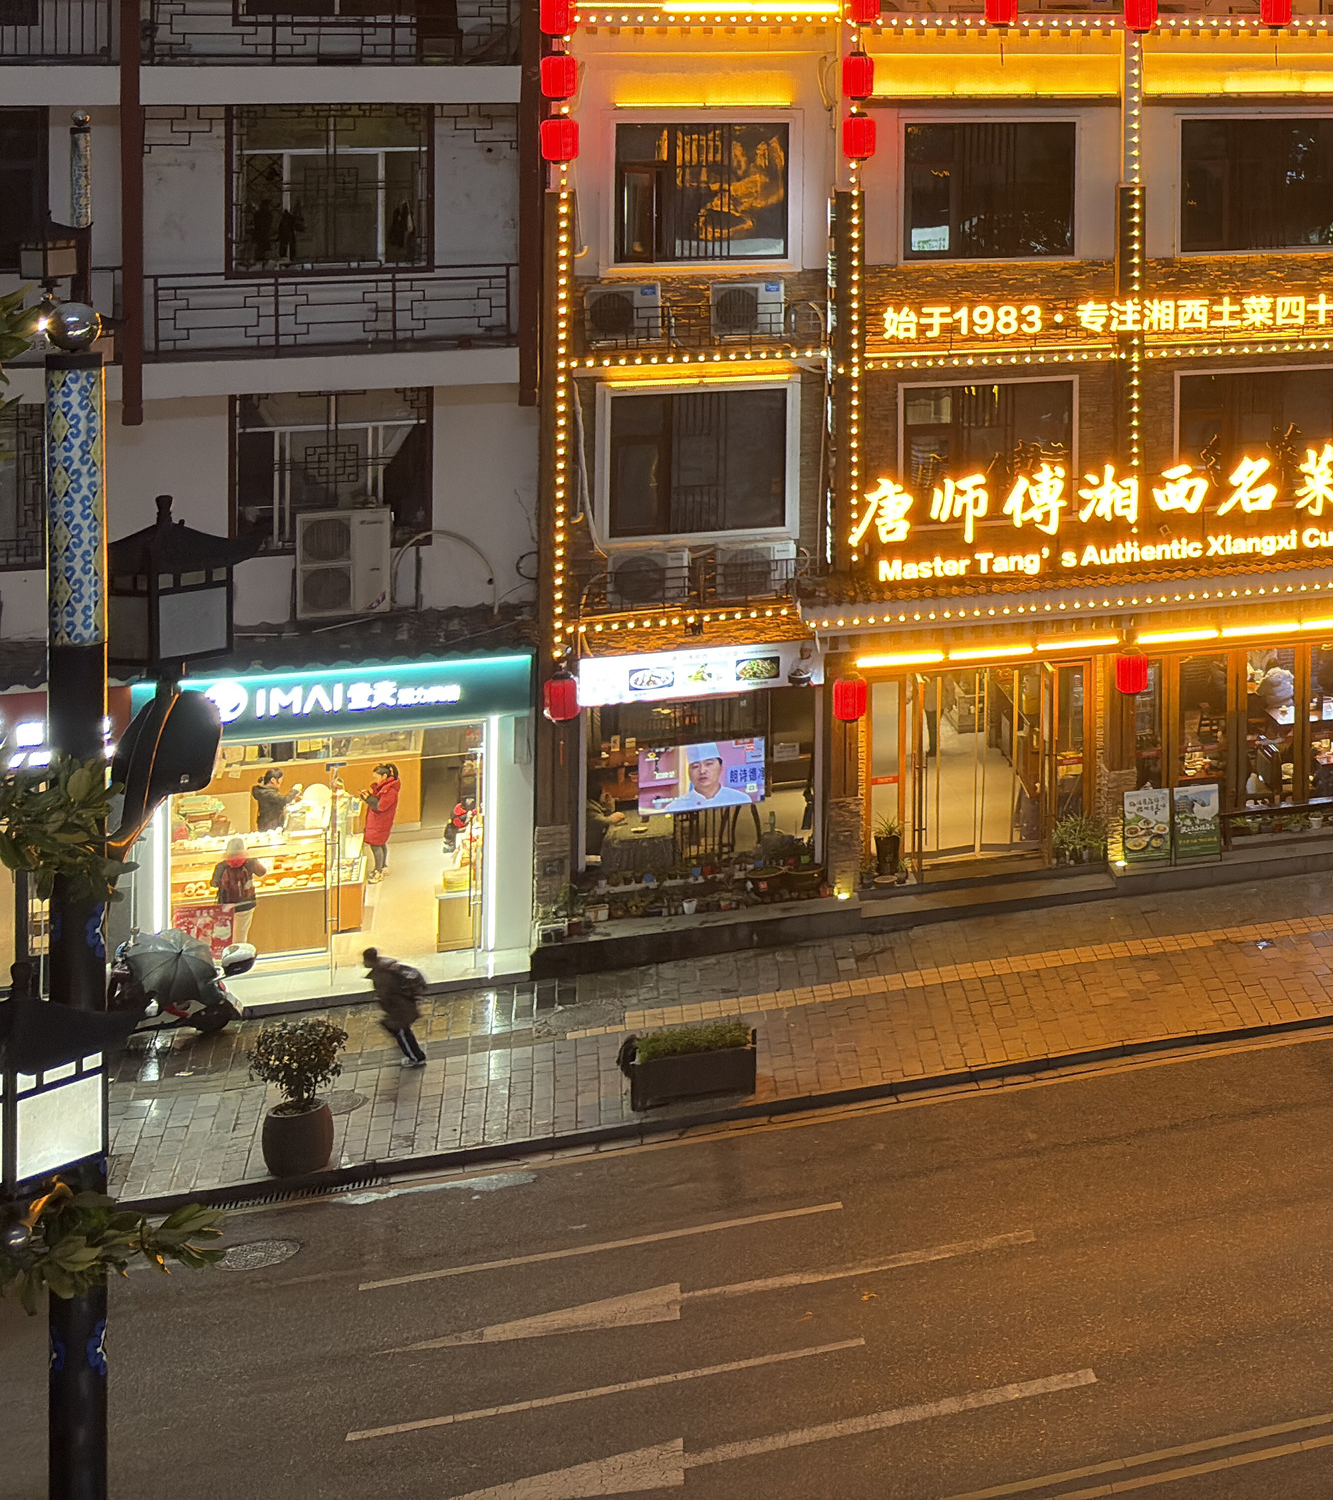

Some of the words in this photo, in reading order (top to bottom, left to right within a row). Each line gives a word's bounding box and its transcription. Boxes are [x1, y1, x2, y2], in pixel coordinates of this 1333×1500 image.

[878, 556, 970, 582] Master
[1081, 538, 1203, 567] Authentic
[1207, 529, 1298, 557] Xiangxi
[255, 682, 343, 719] IMAI
